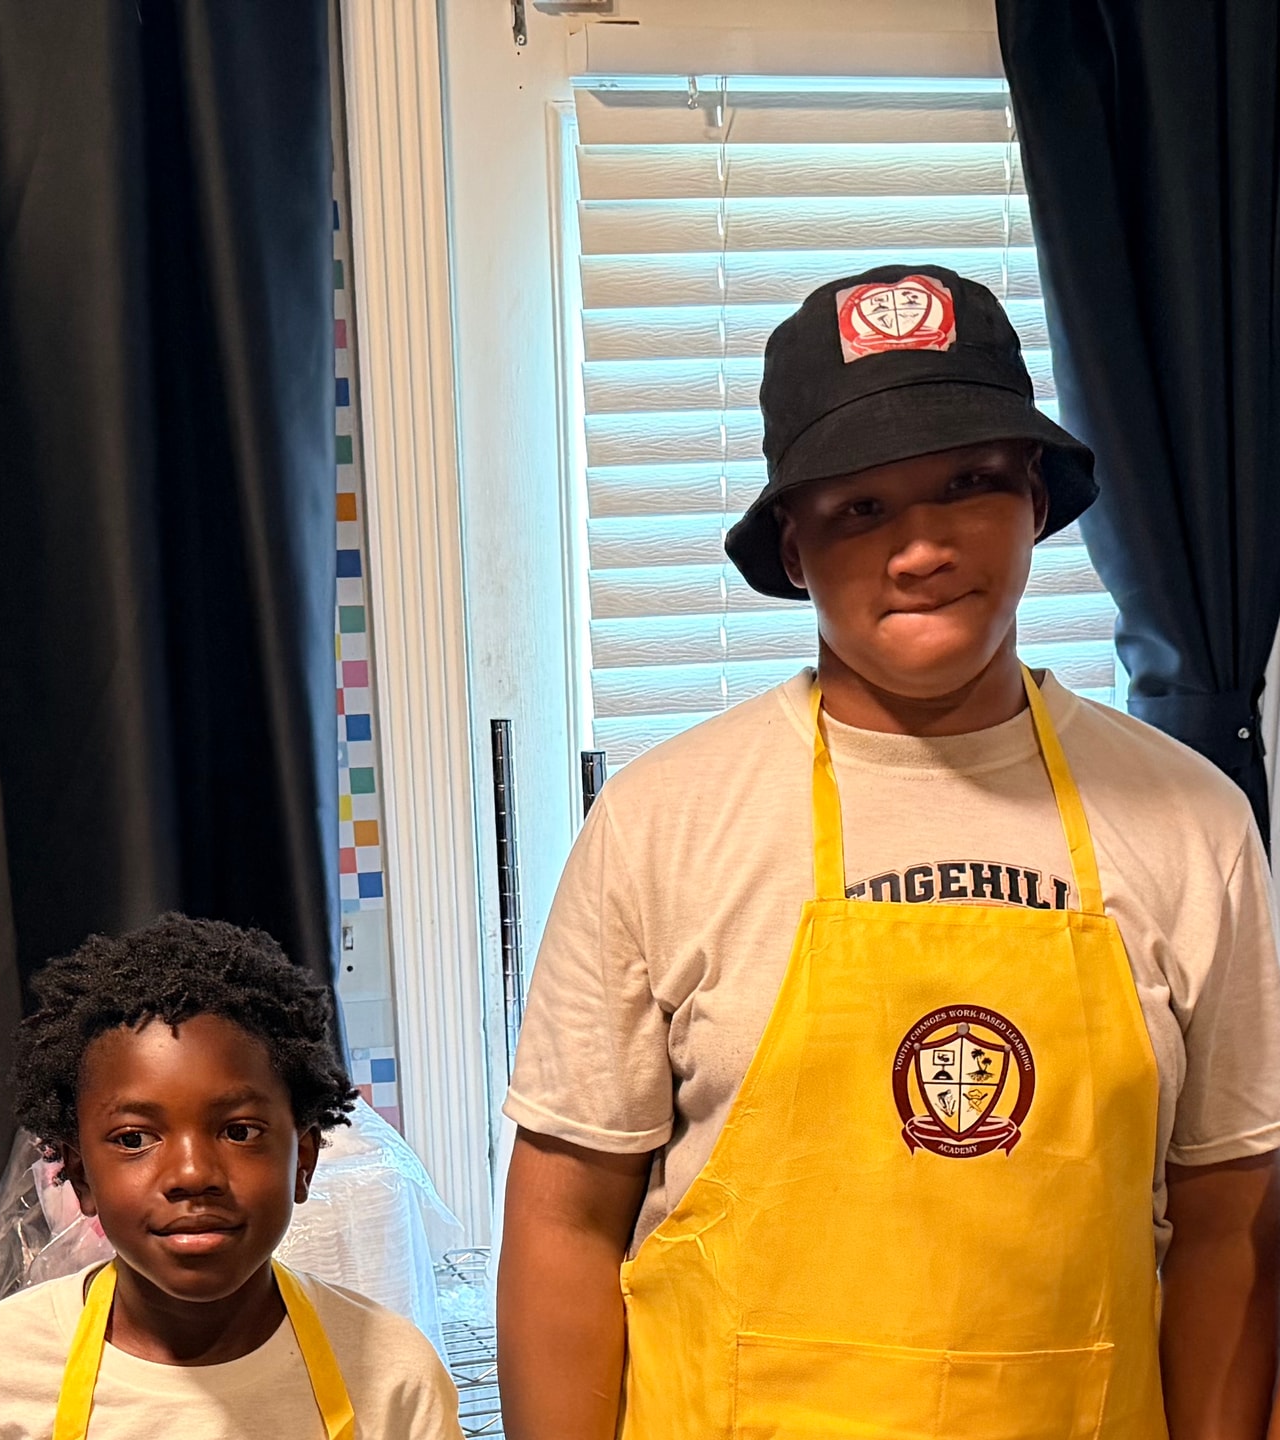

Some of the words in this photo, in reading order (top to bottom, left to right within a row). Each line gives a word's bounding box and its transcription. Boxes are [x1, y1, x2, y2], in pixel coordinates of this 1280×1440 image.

[894, 1041, 913, 1072] YOUTH
[910, 1012, 947, 1041] CHANGES
[1006, 1029, 1032, 1072] LEARNING
[938, 1143, 978, 1155] ACADEMY
